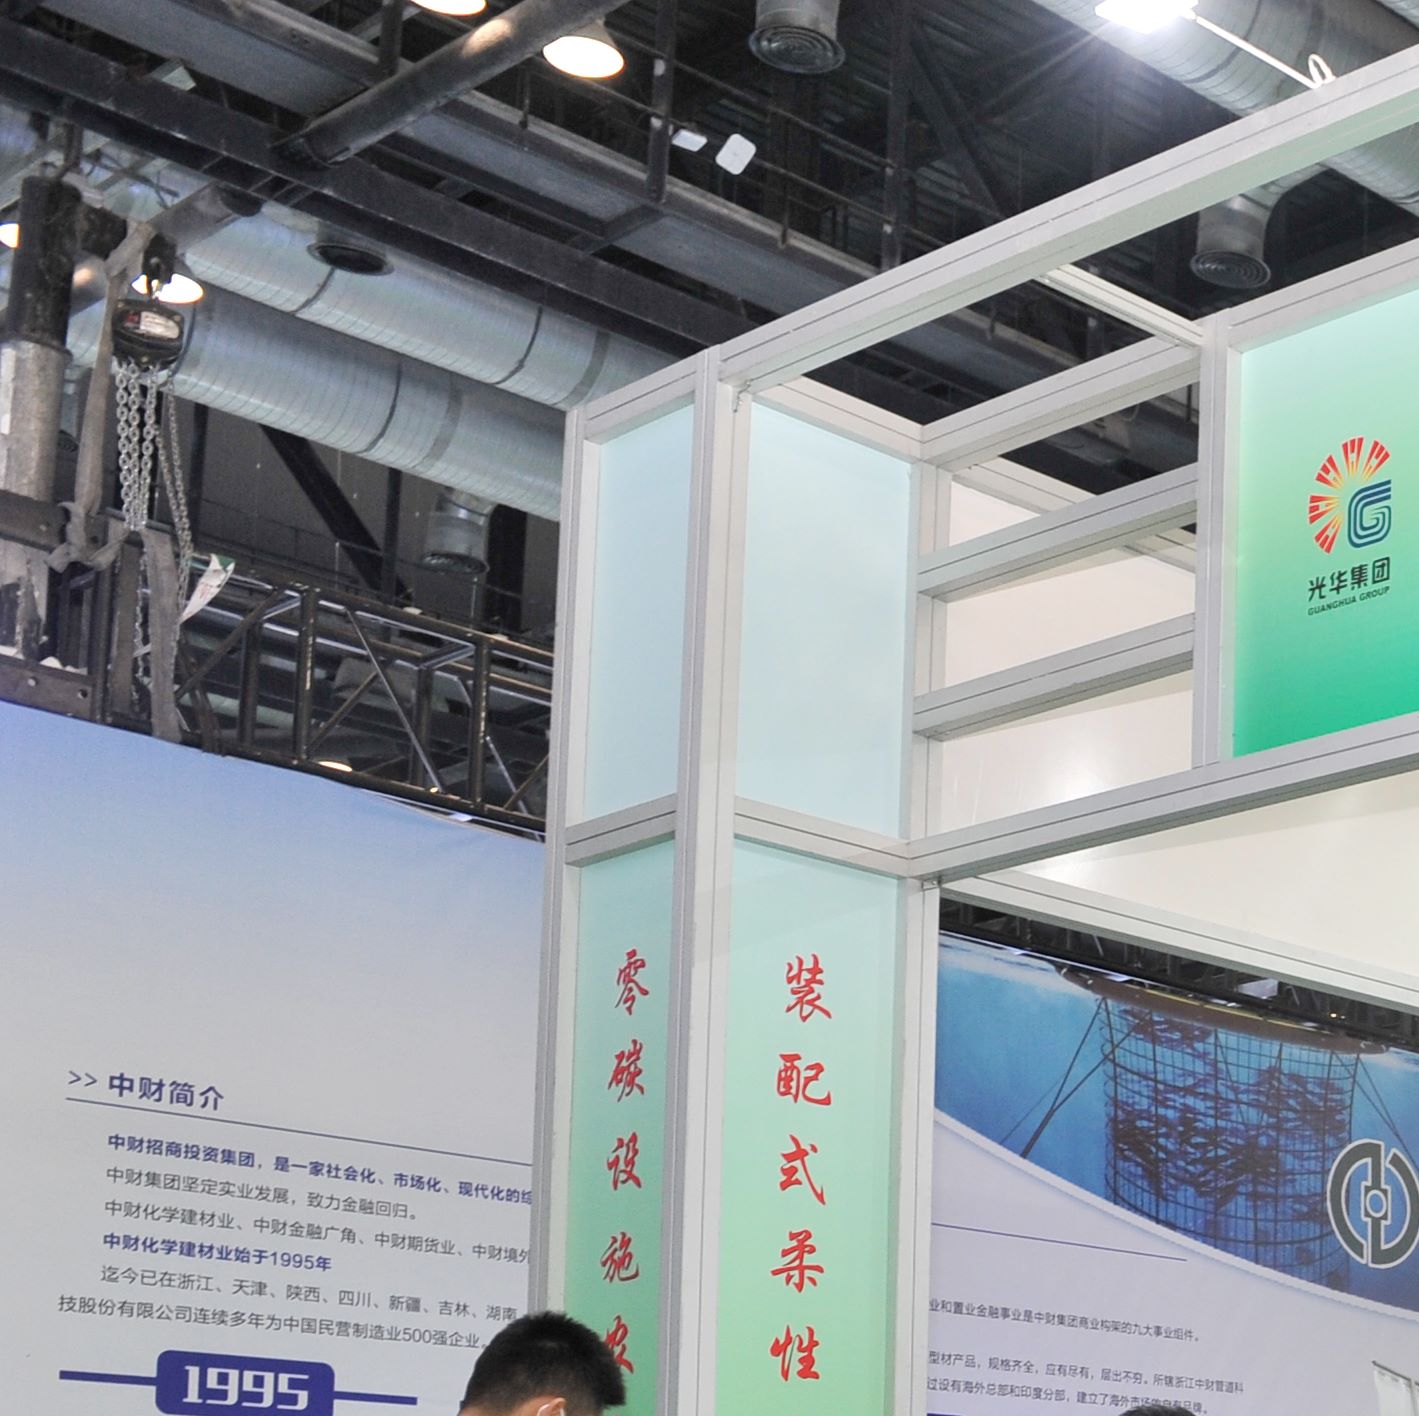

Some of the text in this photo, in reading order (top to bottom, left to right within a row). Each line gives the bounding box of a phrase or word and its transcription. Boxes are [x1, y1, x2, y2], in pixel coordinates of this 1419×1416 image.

[1308, 557, 1390, 601] 光华集团
[1308, 586, 1390, 616] GUANGHUA GROUP
[108, 1072, 224, 1112] 中财简介
[103, 1233, 332, 1272] 中财化学建材业始于1995年
[181, 1366, 309, 1411] 1995
